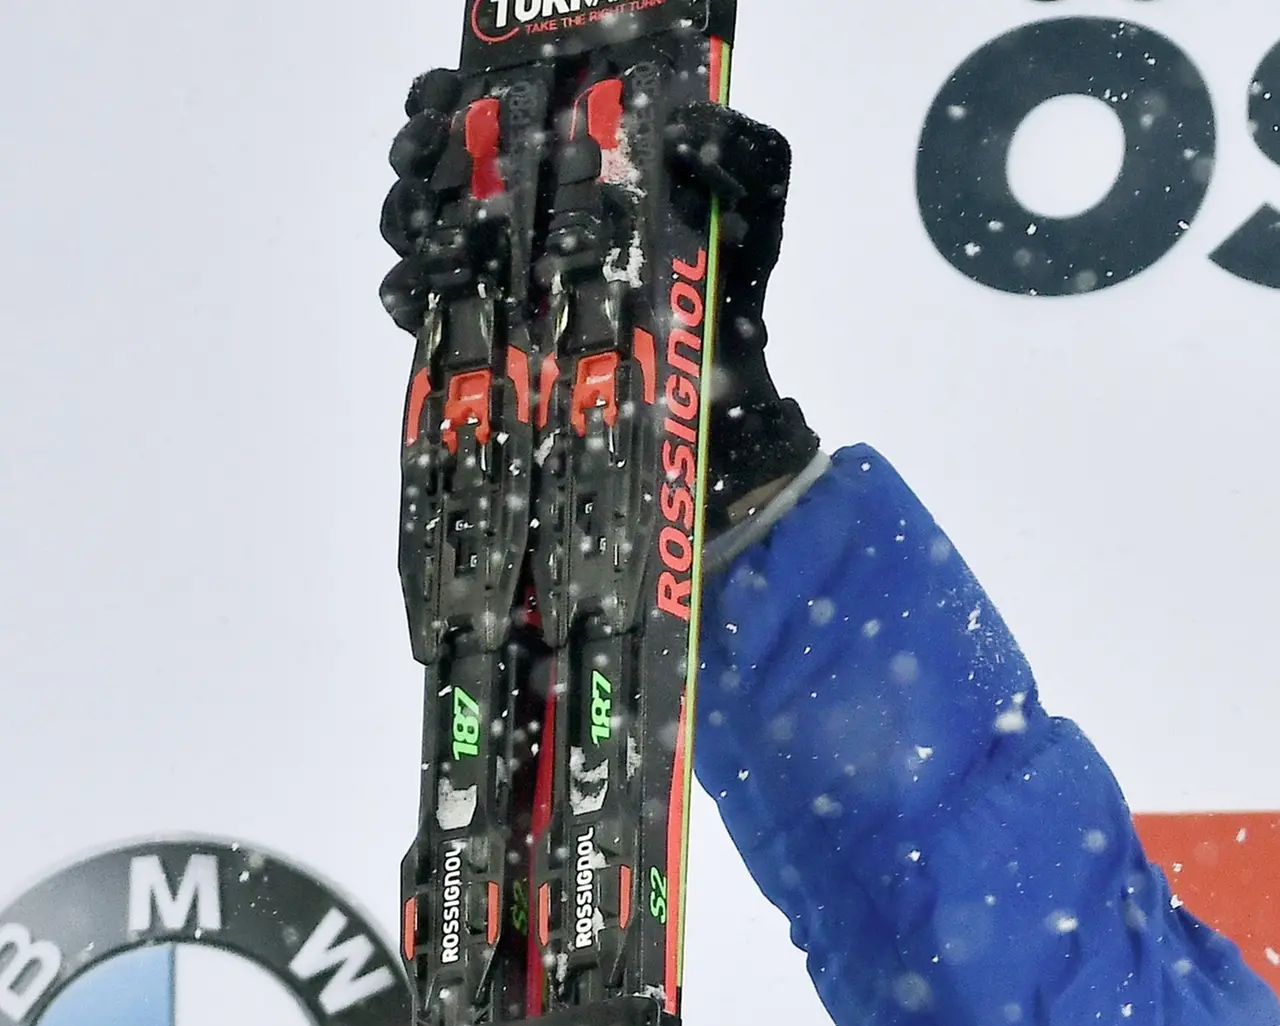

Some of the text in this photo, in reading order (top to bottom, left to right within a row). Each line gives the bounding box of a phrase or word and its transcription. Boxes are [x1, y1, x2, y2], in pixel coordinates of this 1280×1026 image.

[525, 19, 558, 34] TAKE
[561, 13, 586, 28] THE
[656, 247, 706, 620] ROSSIGNOL
[452, 686, 481, 760] 187
[589, 670, 613, 745] 187
[441, 845, 462, 964] ROSSIGNOL
[575, 826, 595, 948] ROSSIGNOL
[649, 866, 668, 924] S2
[0, 854, 397, 1023] BMW
